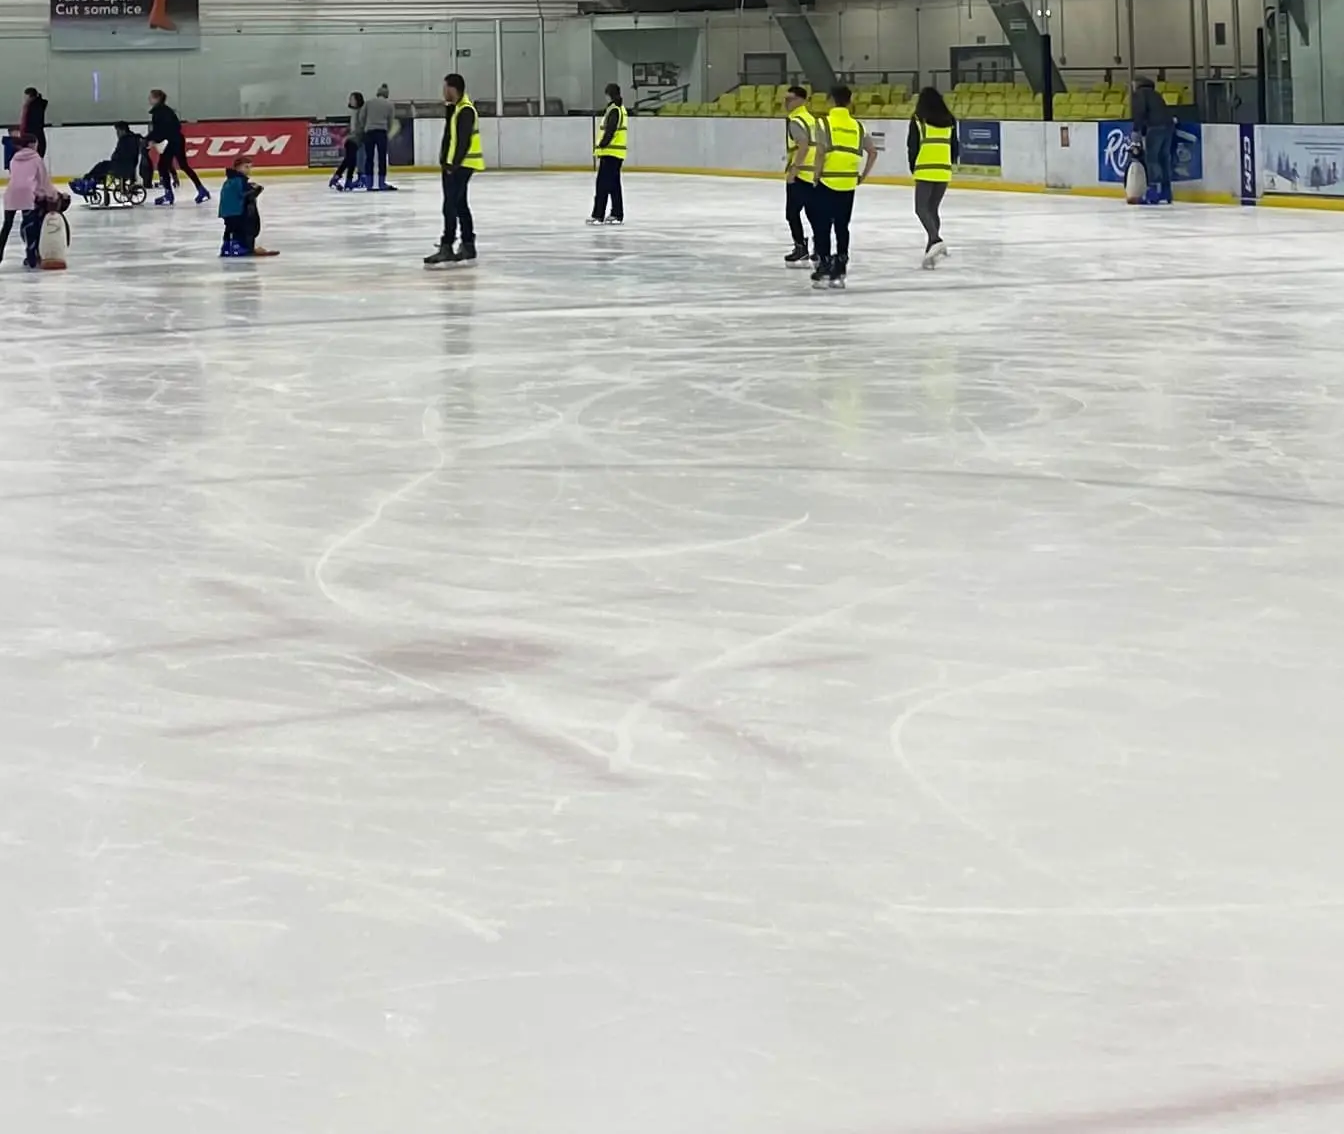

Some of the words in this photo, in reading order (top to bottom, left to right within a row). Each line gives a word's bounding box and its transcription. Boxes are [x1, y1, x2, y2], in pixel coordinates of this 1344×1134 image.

[55, 3, 80, 16] Cut
[83, 5, 119, 16] some
[309, 136, 332, 146] ZERO
[1243, 135, 1253, 193] CCM
